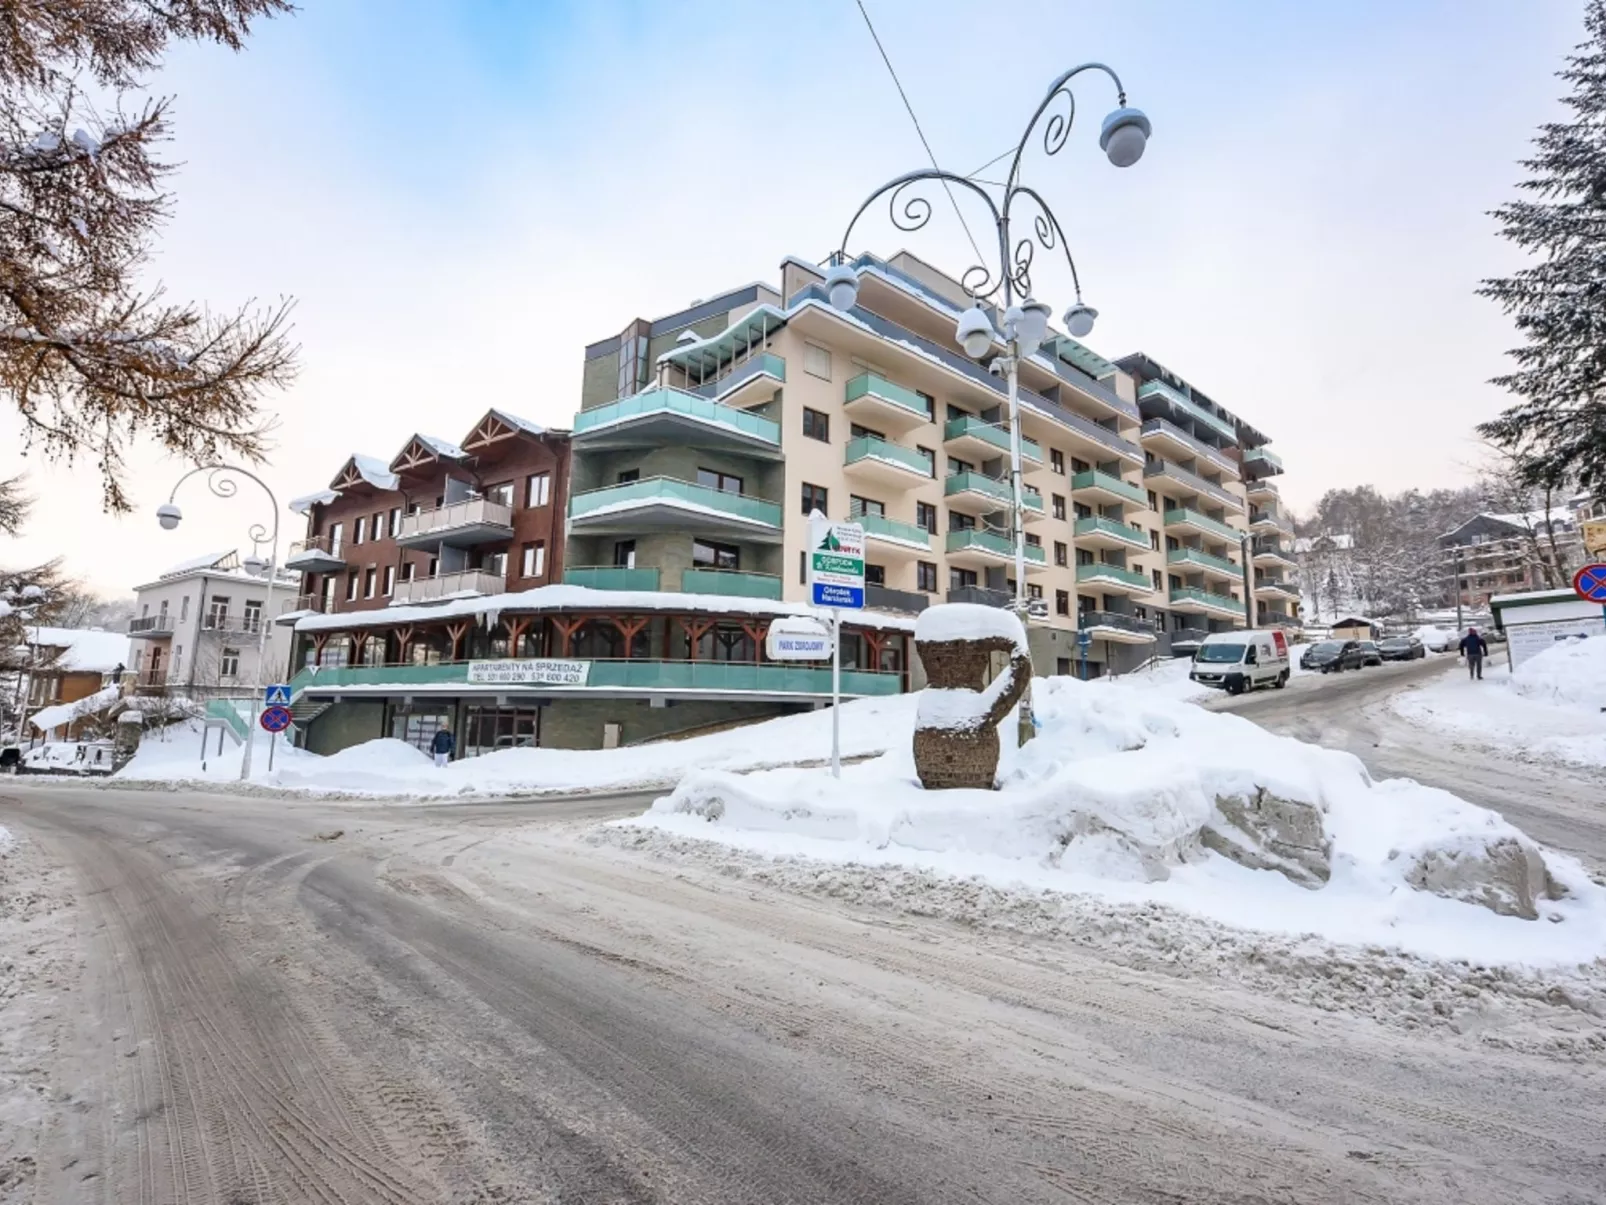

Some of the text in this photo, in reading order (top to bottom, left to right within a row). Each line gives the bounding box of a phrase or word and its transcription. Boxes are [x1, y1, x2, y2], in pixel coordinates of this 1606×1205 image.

[778, 640, 793, 651] PARK
[522, 662, 533, 672] NA
[535, 662, 583, 673] SPRZEDAŻ
